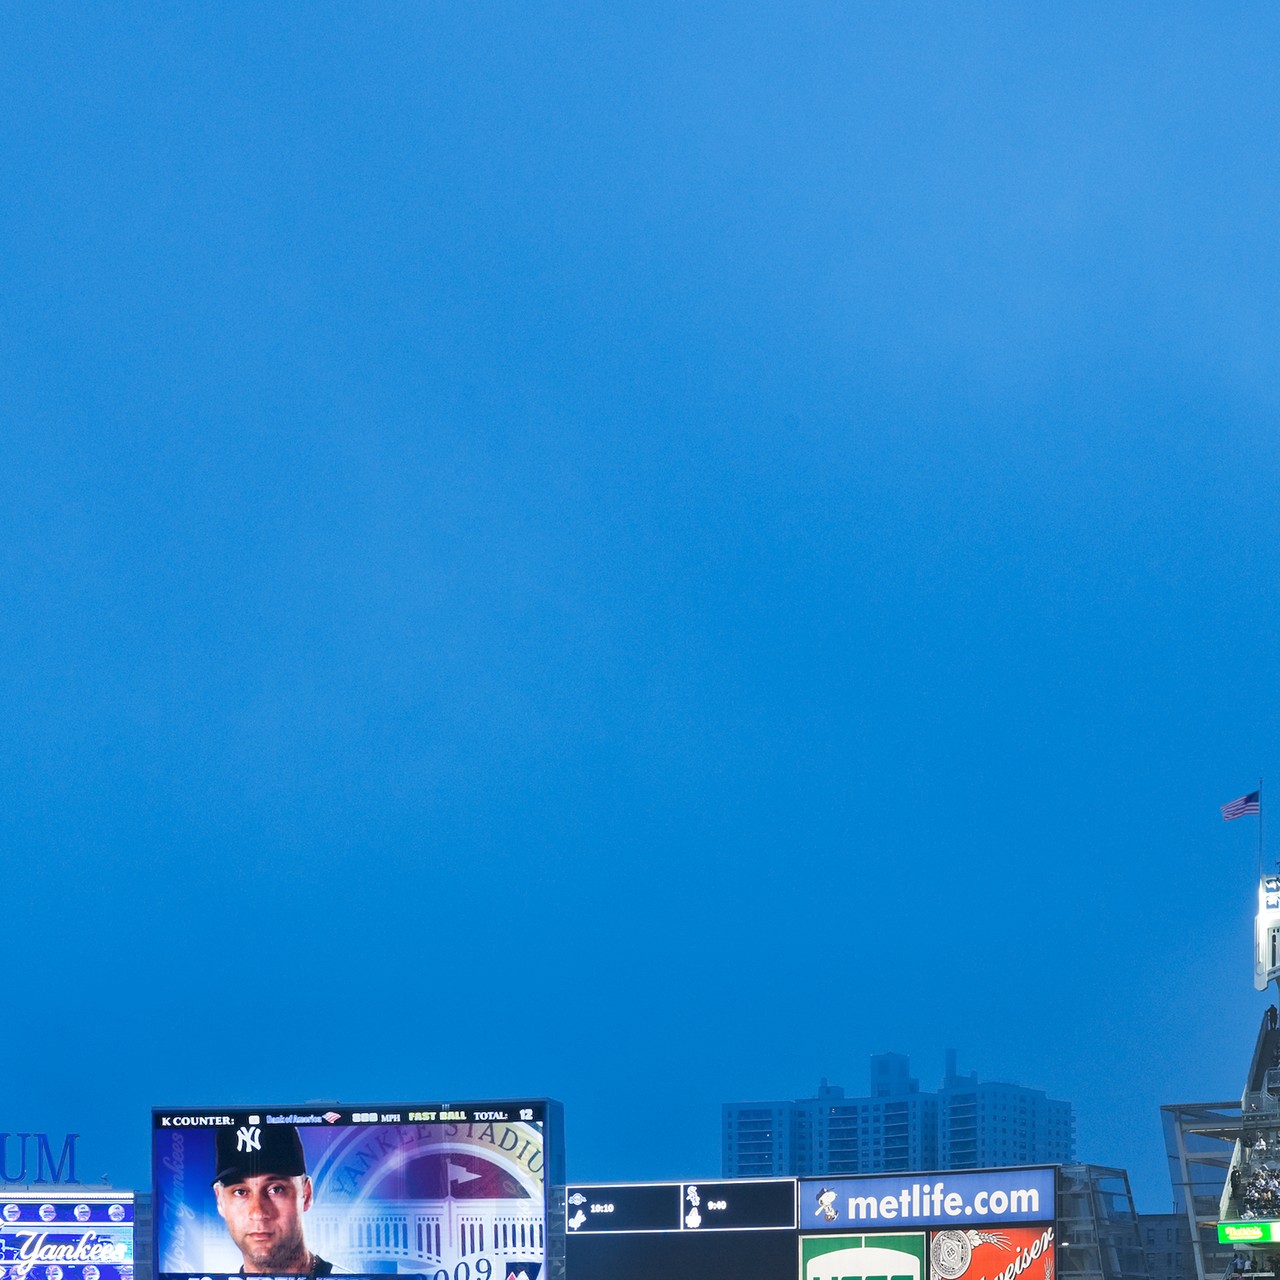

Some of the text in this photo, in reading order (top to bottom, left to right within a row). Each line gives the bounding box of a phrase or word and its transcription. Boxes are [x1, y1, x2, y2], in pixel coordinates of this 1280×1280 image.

[381, 1114, 401, 1122] MPH
[408, 1111, 467, 1120] FAST BALL
[473, 1109, 533, 1120] TOTAL: 12
[162, 1116, 235, 1126] K COUNTER:
[848, 1185, 1040, 1220] metlife.com
[16, 1230, 126, 1275] Yankees
